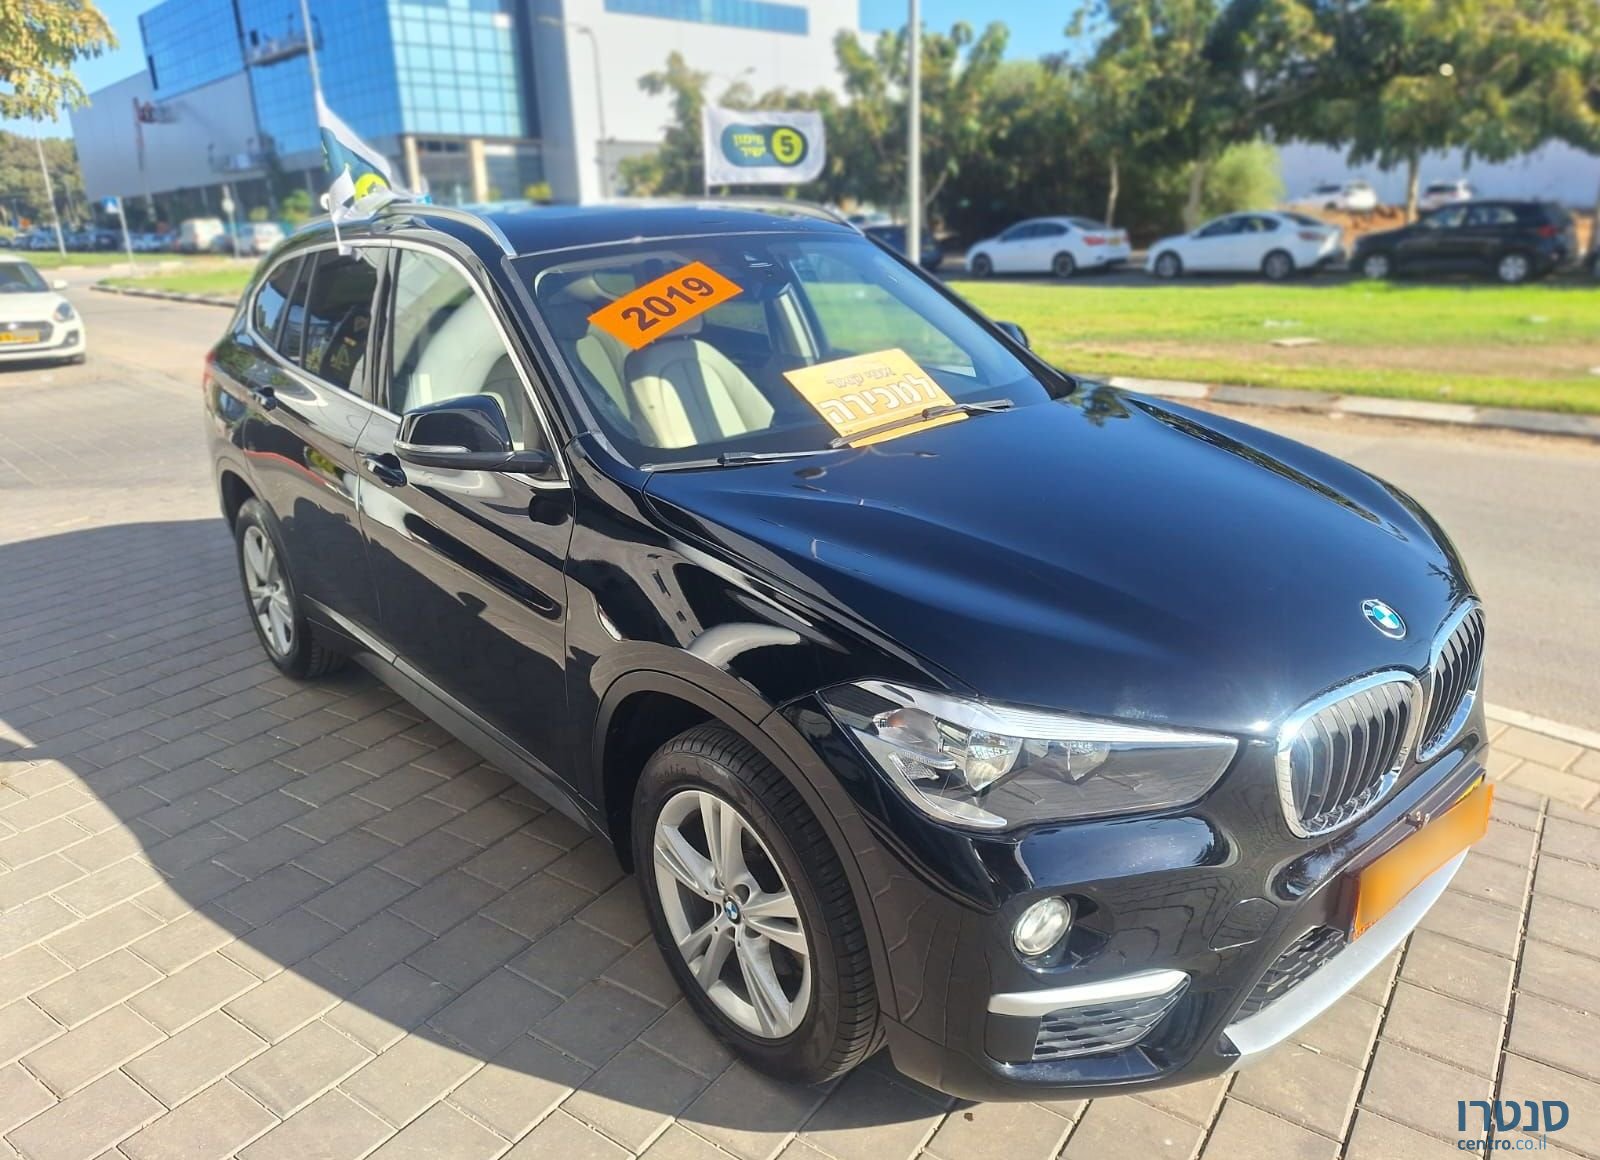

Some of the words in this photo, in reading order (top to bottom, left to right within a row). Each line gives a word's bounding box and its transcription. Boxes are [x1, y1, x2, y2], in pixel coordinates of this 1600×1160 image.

[780, 135, 795, 156] 5
[621, 277, 714, 331] 2019
[818, 373, 938, 424] למכירה
